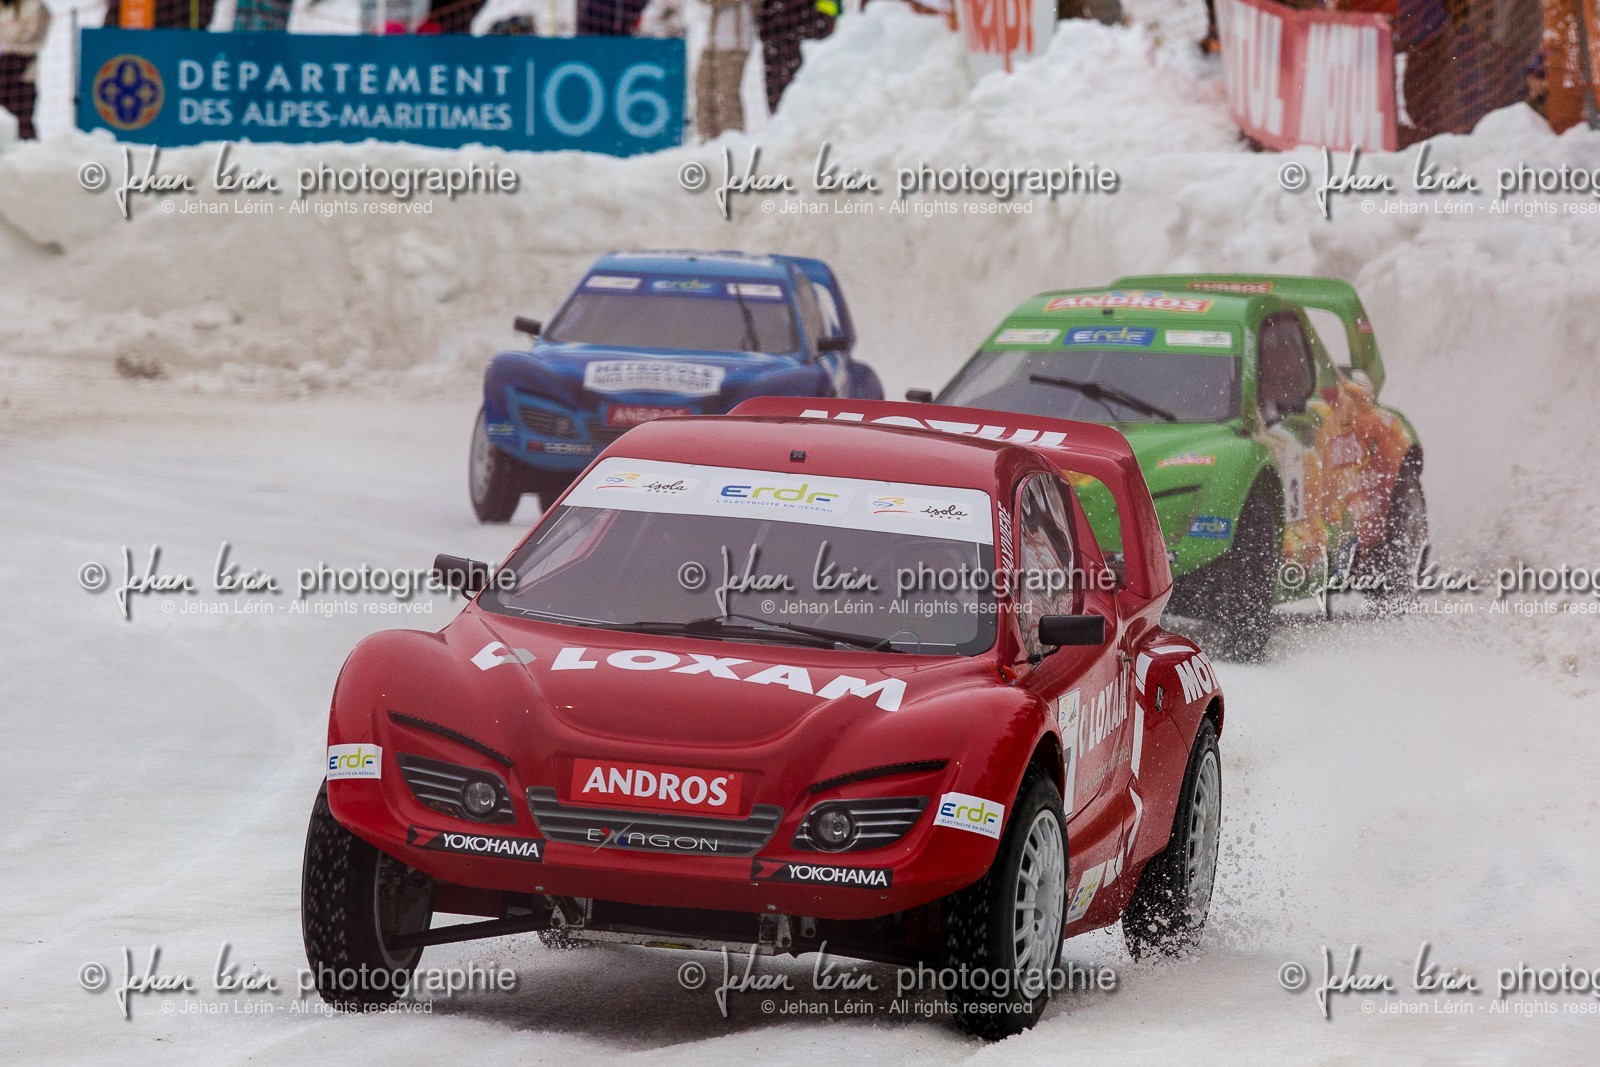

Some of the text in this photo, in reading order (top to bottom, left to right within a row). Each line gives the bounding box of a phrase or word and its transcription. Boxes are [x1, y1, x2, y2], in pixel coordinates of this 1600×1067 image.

[178, 52, 511, 97] DÉPARTEMENT
[543, 61, 671, 138] 06
[178, 98, 512, 131] DES ALPES-MARITIMES
[1051, 295, 1206, 312] ANDROS
[642, 480, 688, 491] isola
[920, 504, 968, 517] isola
[551, 647, 907, 712] LOXAM
[443, 833, 539, 858] YOKOHAMA
[587, 822, 718, 854] EXAGON
[788, 864, 888, 887] YOKOHAMA
